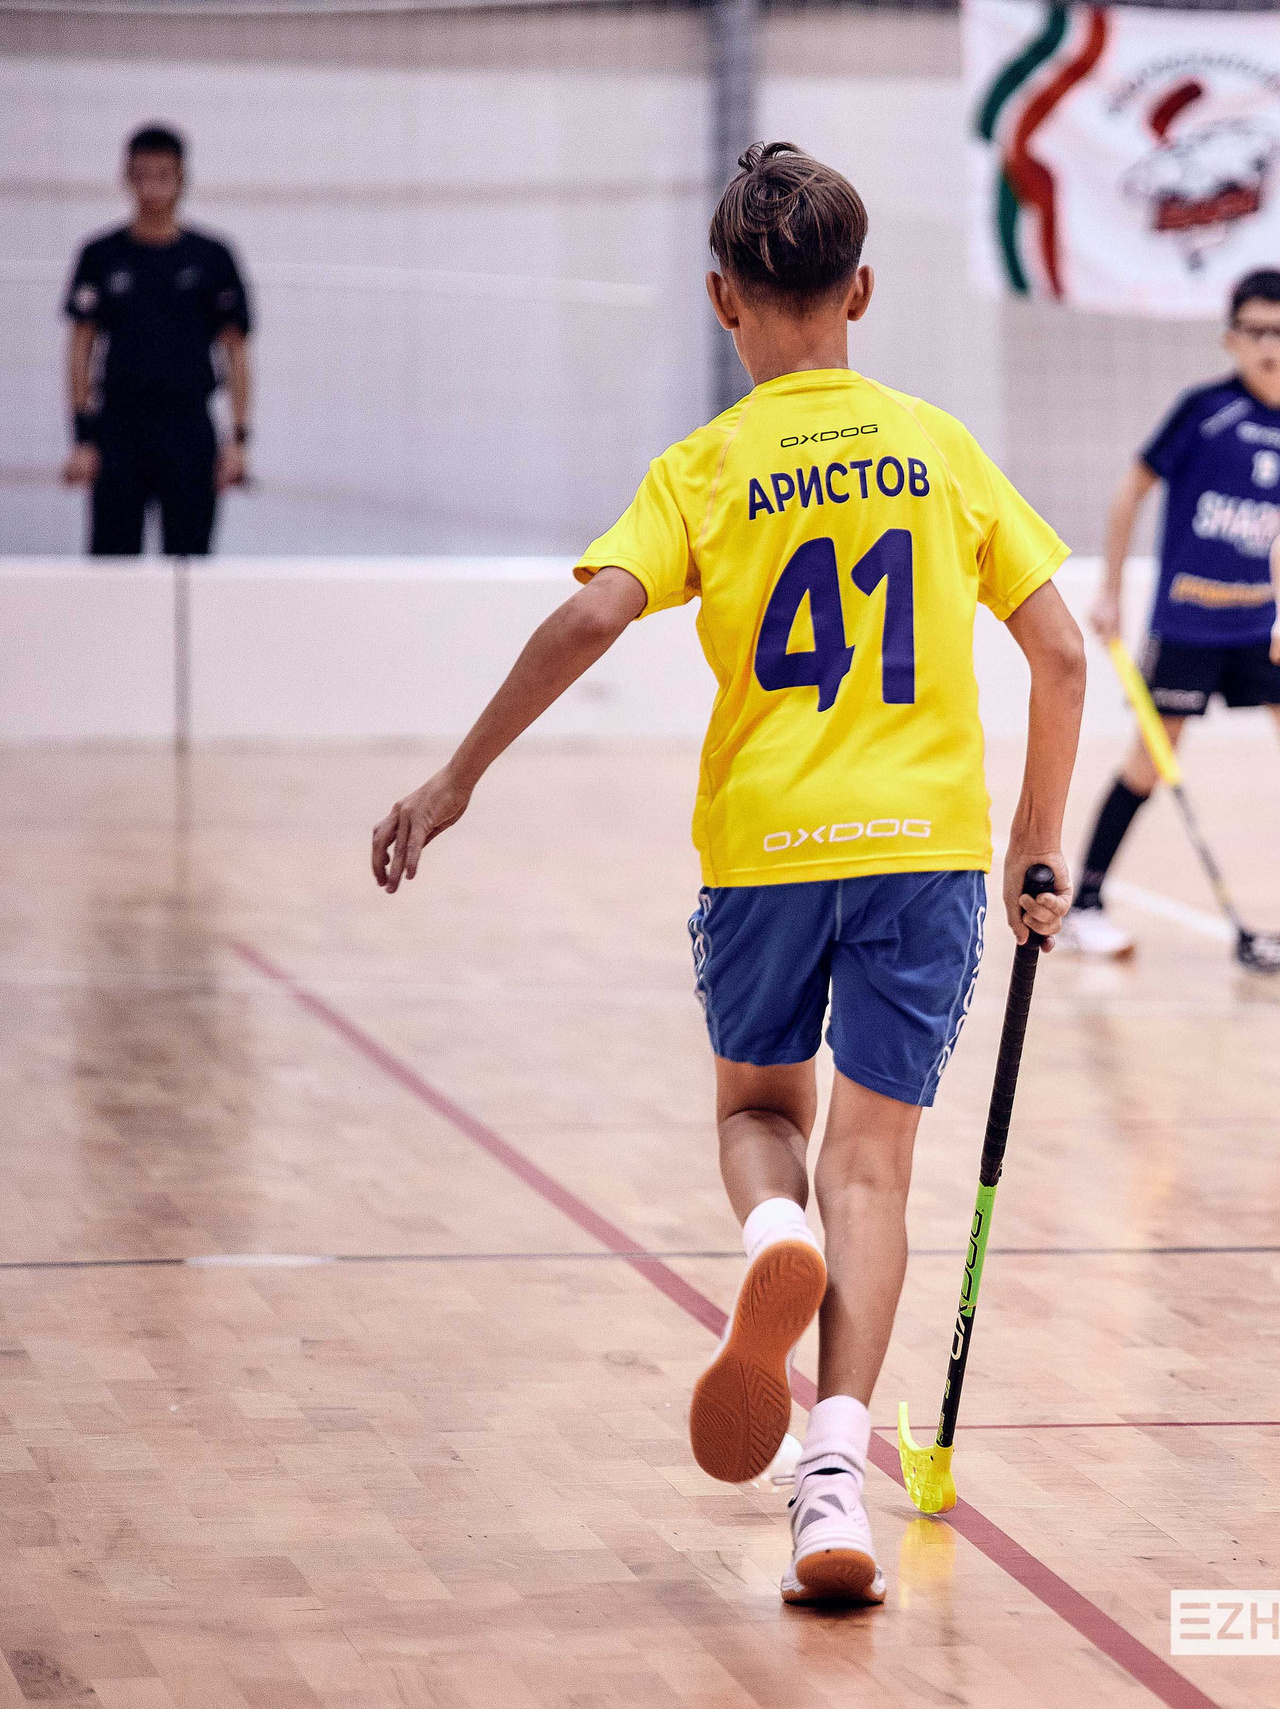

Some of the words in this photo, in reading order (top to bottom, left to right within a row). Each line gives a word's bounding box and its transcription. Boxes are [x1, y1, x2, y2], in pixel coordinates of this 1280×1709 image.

[780, 423, 878, 448] OXDOG
[748, 456, 930, 520] АРИСТОВ
[754, 528, 915, 712] 41
[763, 818, 931, 853] OXDOG
